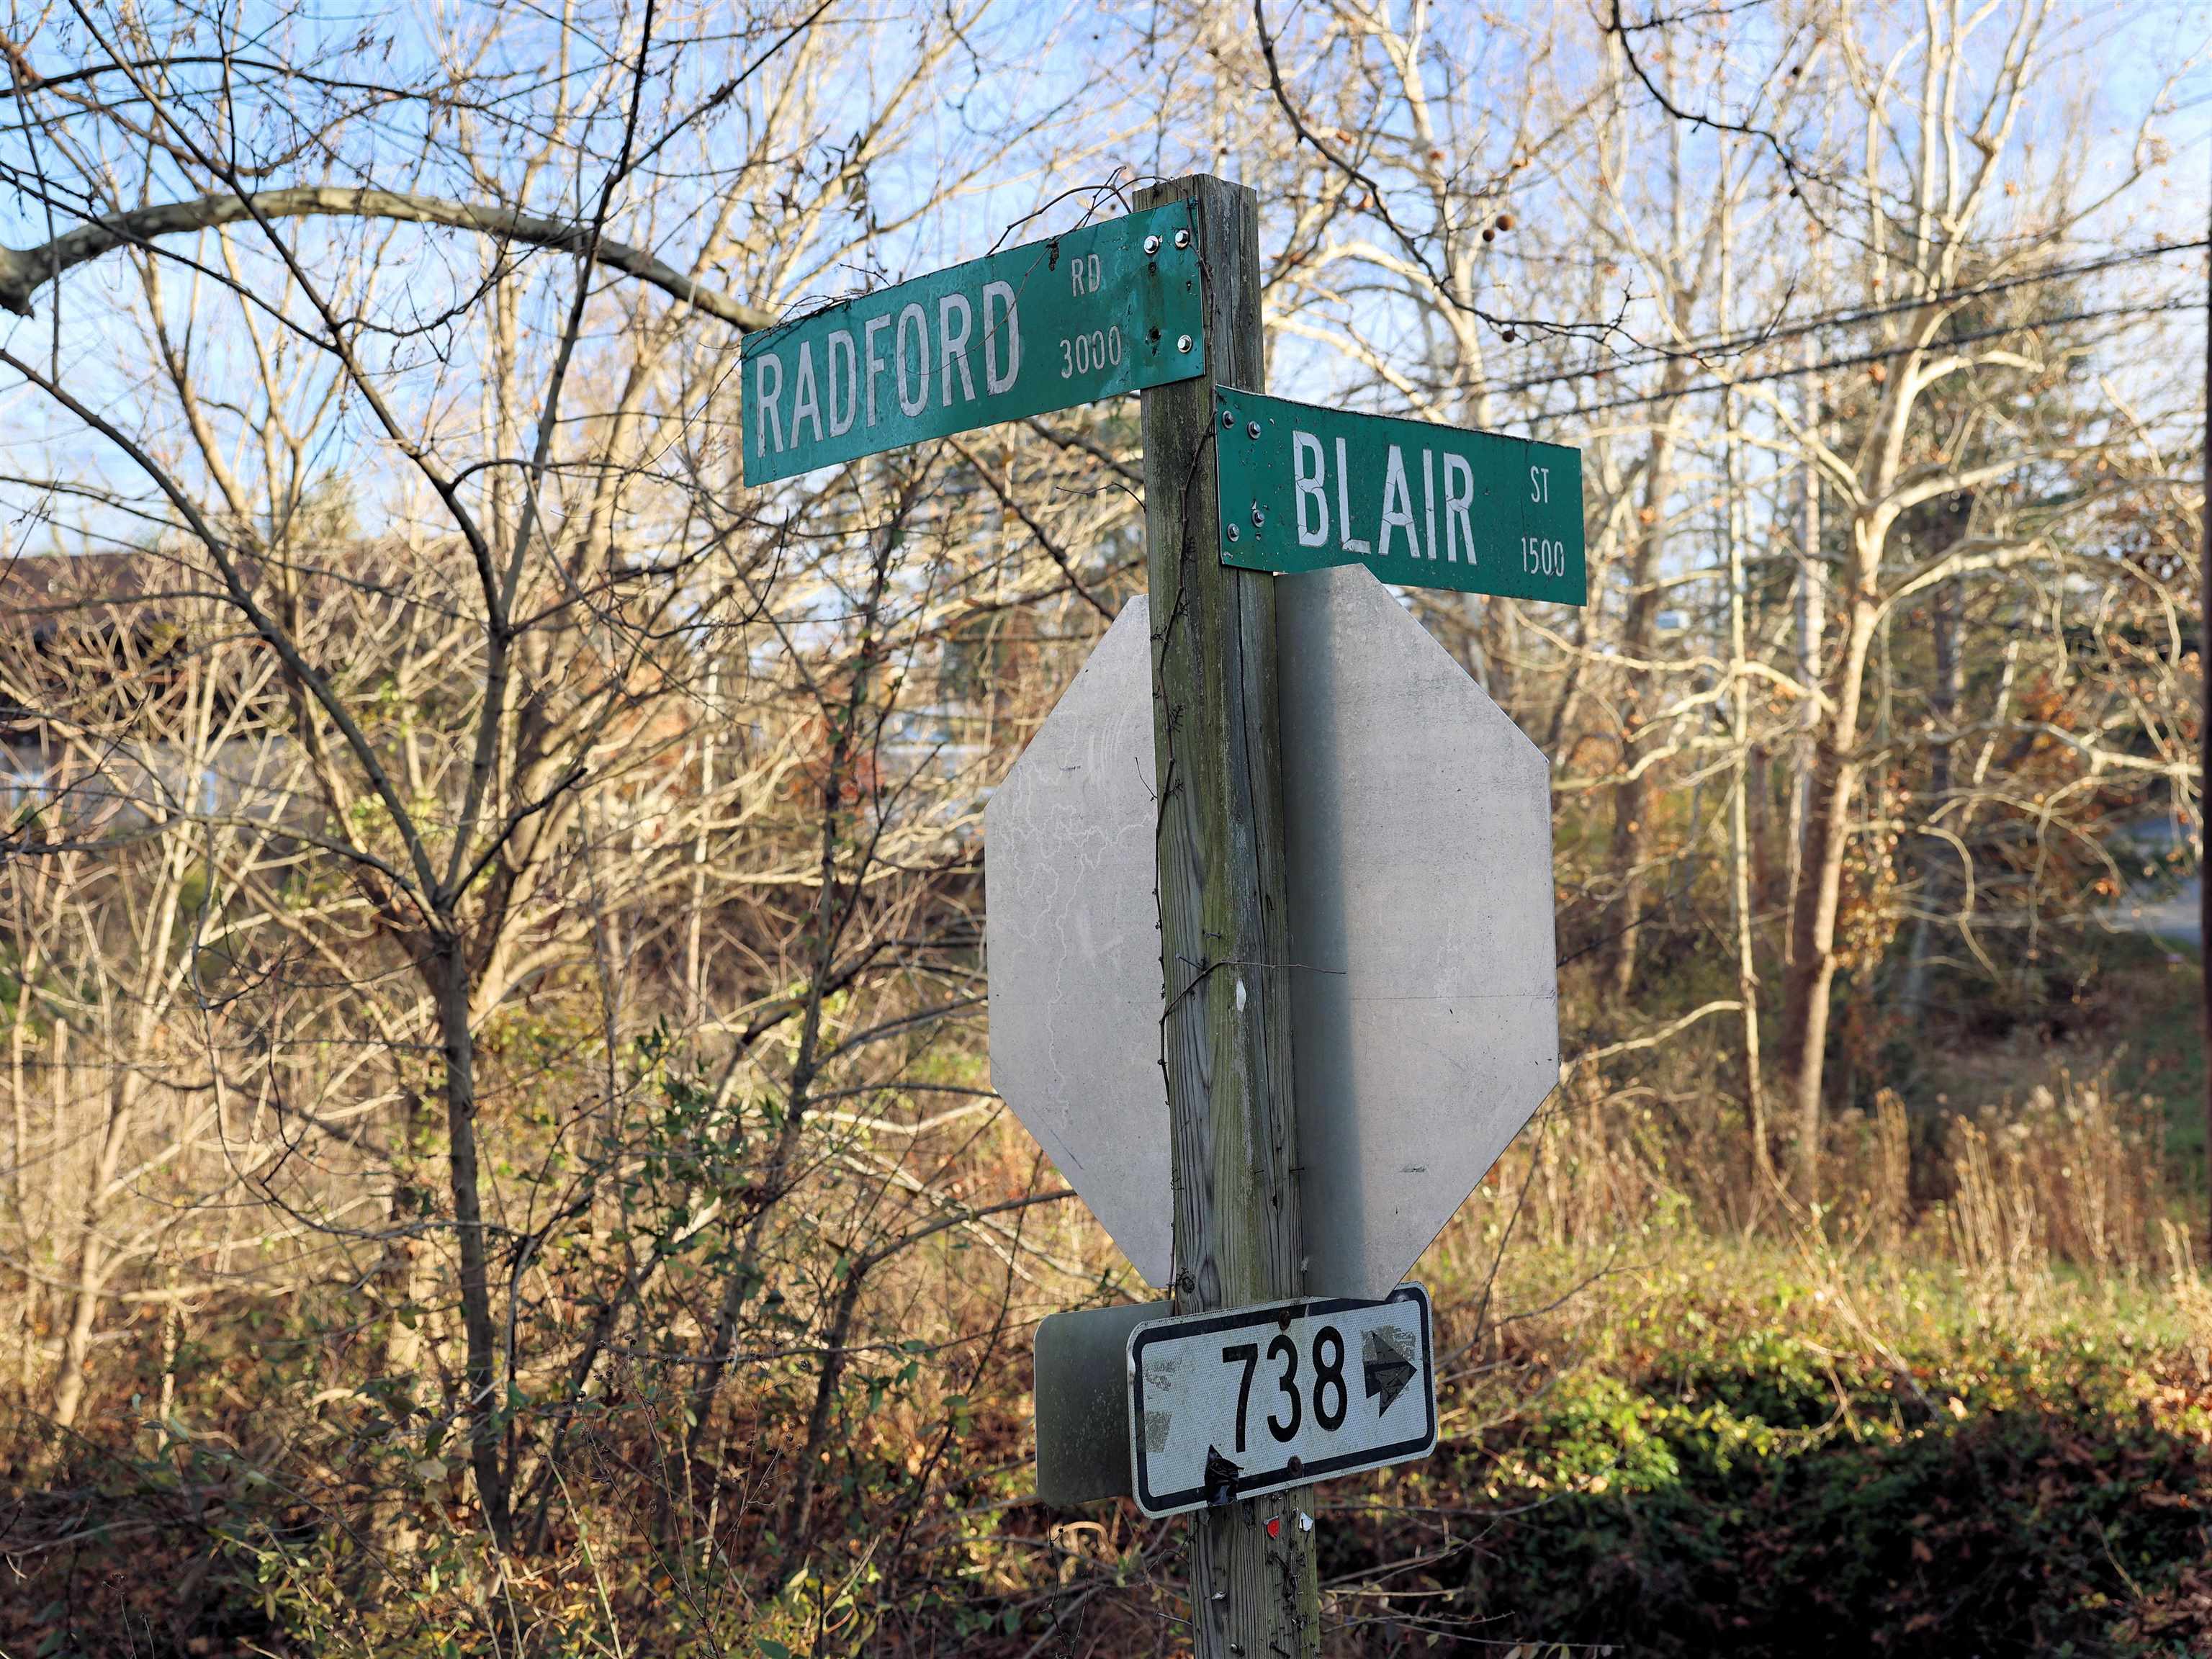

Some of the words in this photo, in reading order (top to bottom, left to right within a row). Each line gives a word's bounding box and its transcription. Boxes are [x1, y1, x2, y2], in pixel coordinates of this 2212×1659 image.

[1071, 253, 1102, 297] RD
[756, 280, 1021, 459] RADFORD
[1059, 325, 1122, 379] 3000
[1292, 430, 1478, 565] BLAIR
[1531, 465, 1550, 504] ST
[1521, 536, 1565, 577] 1500
[1223, 1326, 1348, 1453] 738
